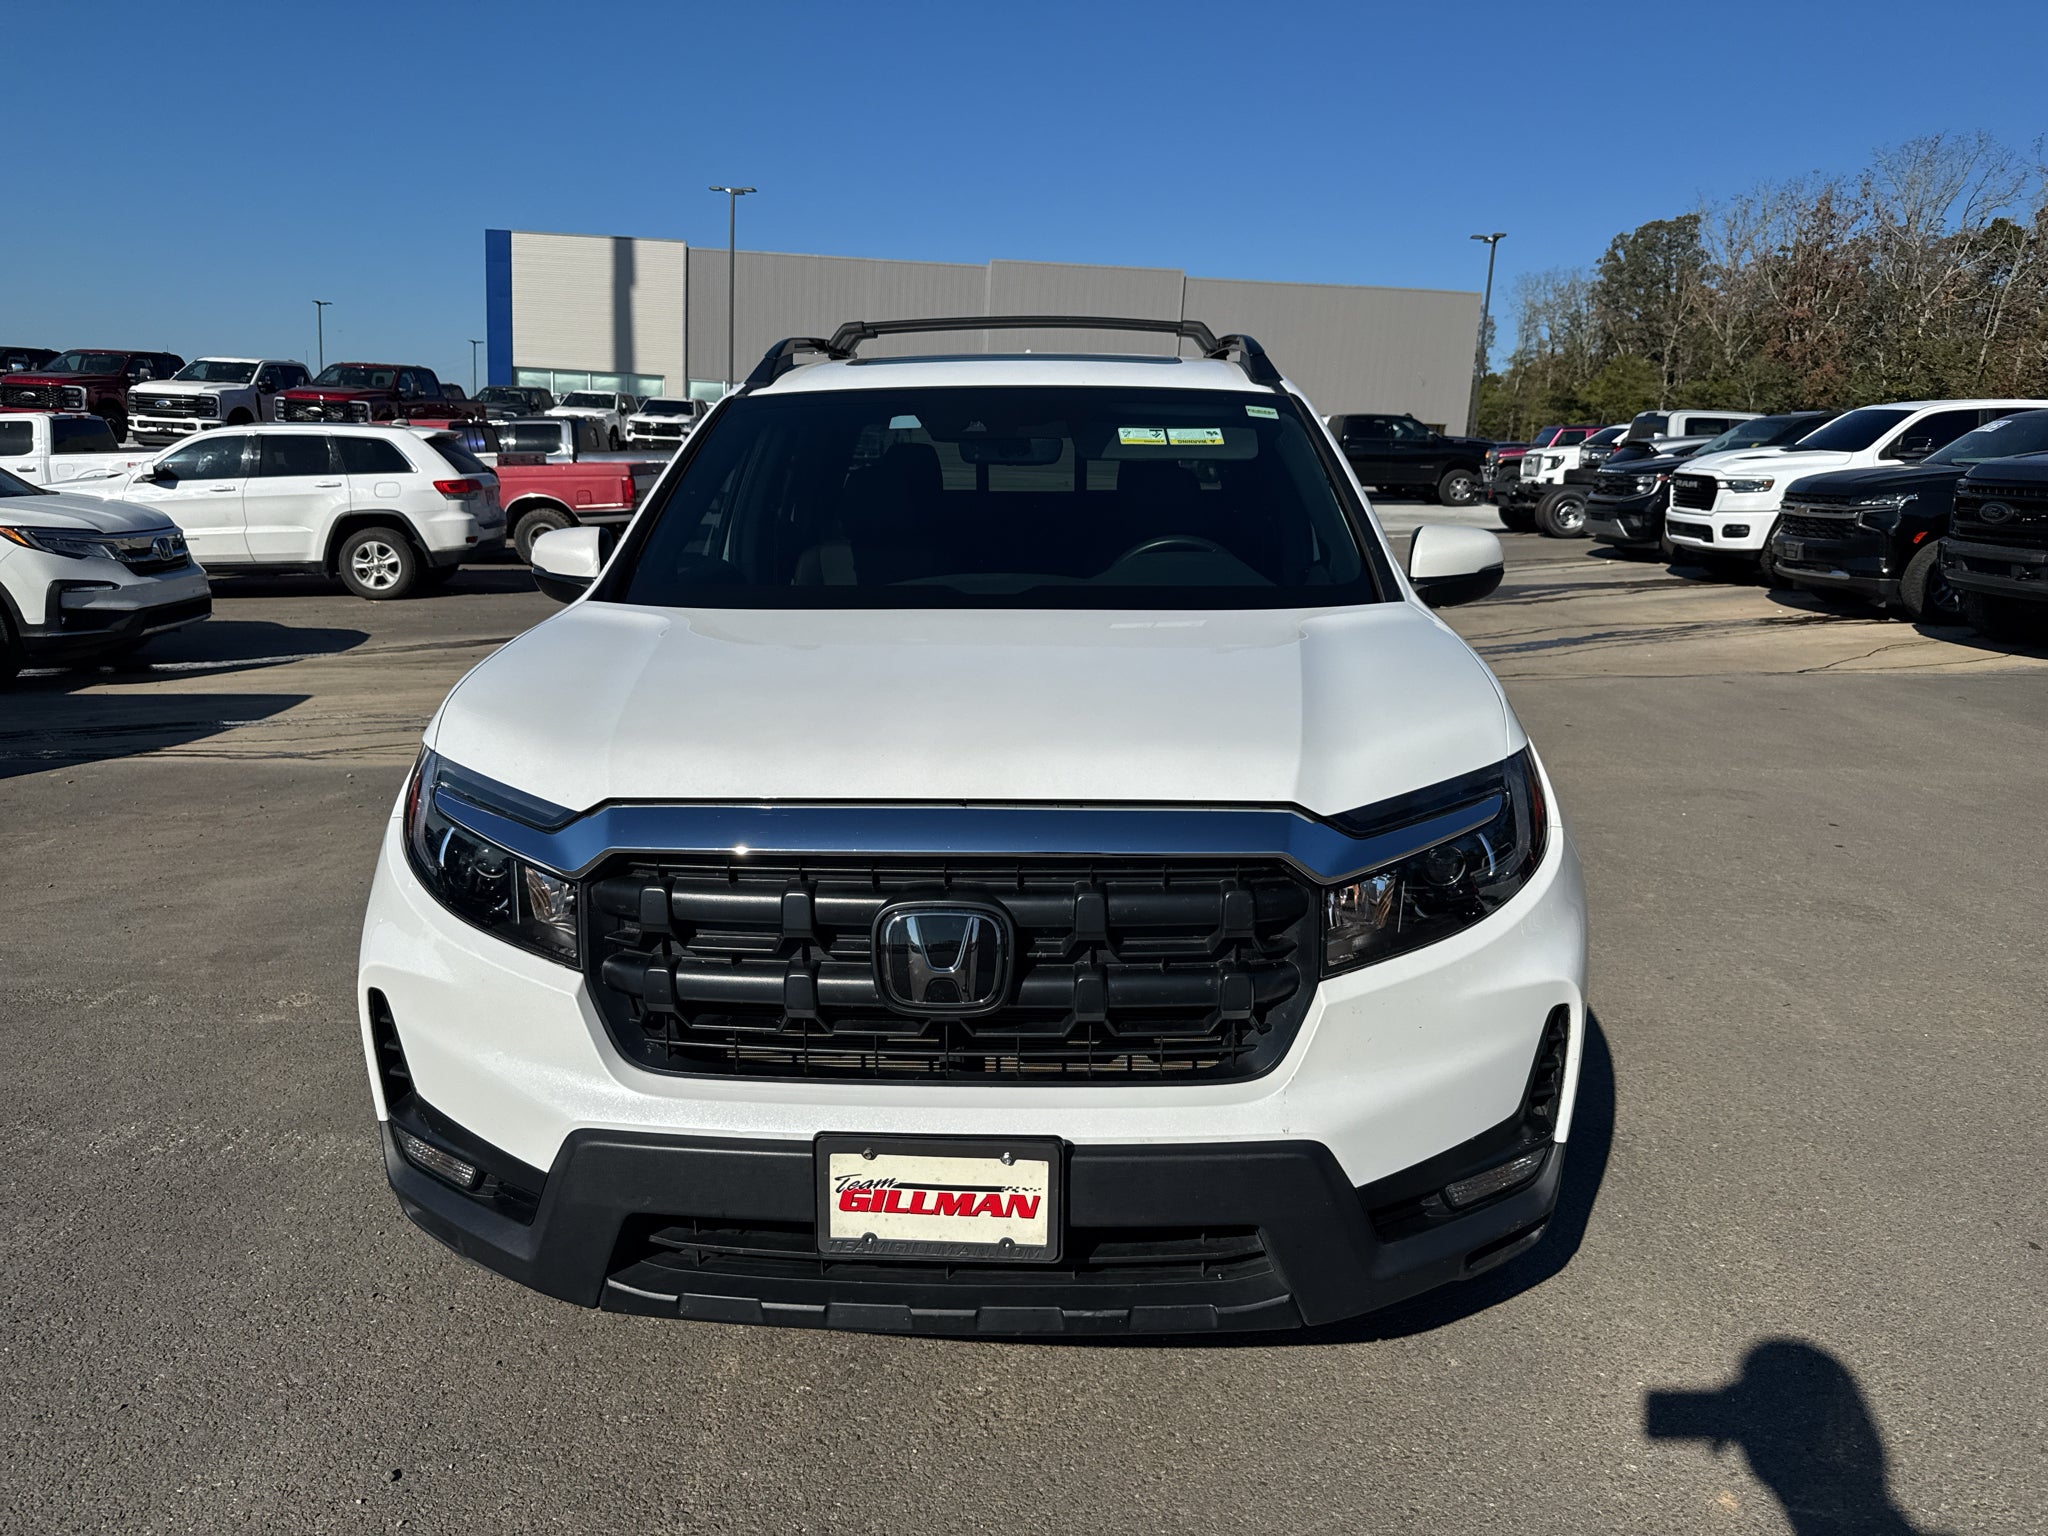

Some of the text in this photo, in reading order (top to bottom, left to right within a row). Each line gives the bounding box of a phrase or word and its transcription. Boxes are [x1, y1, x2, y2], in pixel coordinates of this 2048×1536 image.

[1676, 480, 1698, 488] RAM
[834, 1173, 897, 1193] Team
[839, 1189, 1041, 1219] GILLMAN
